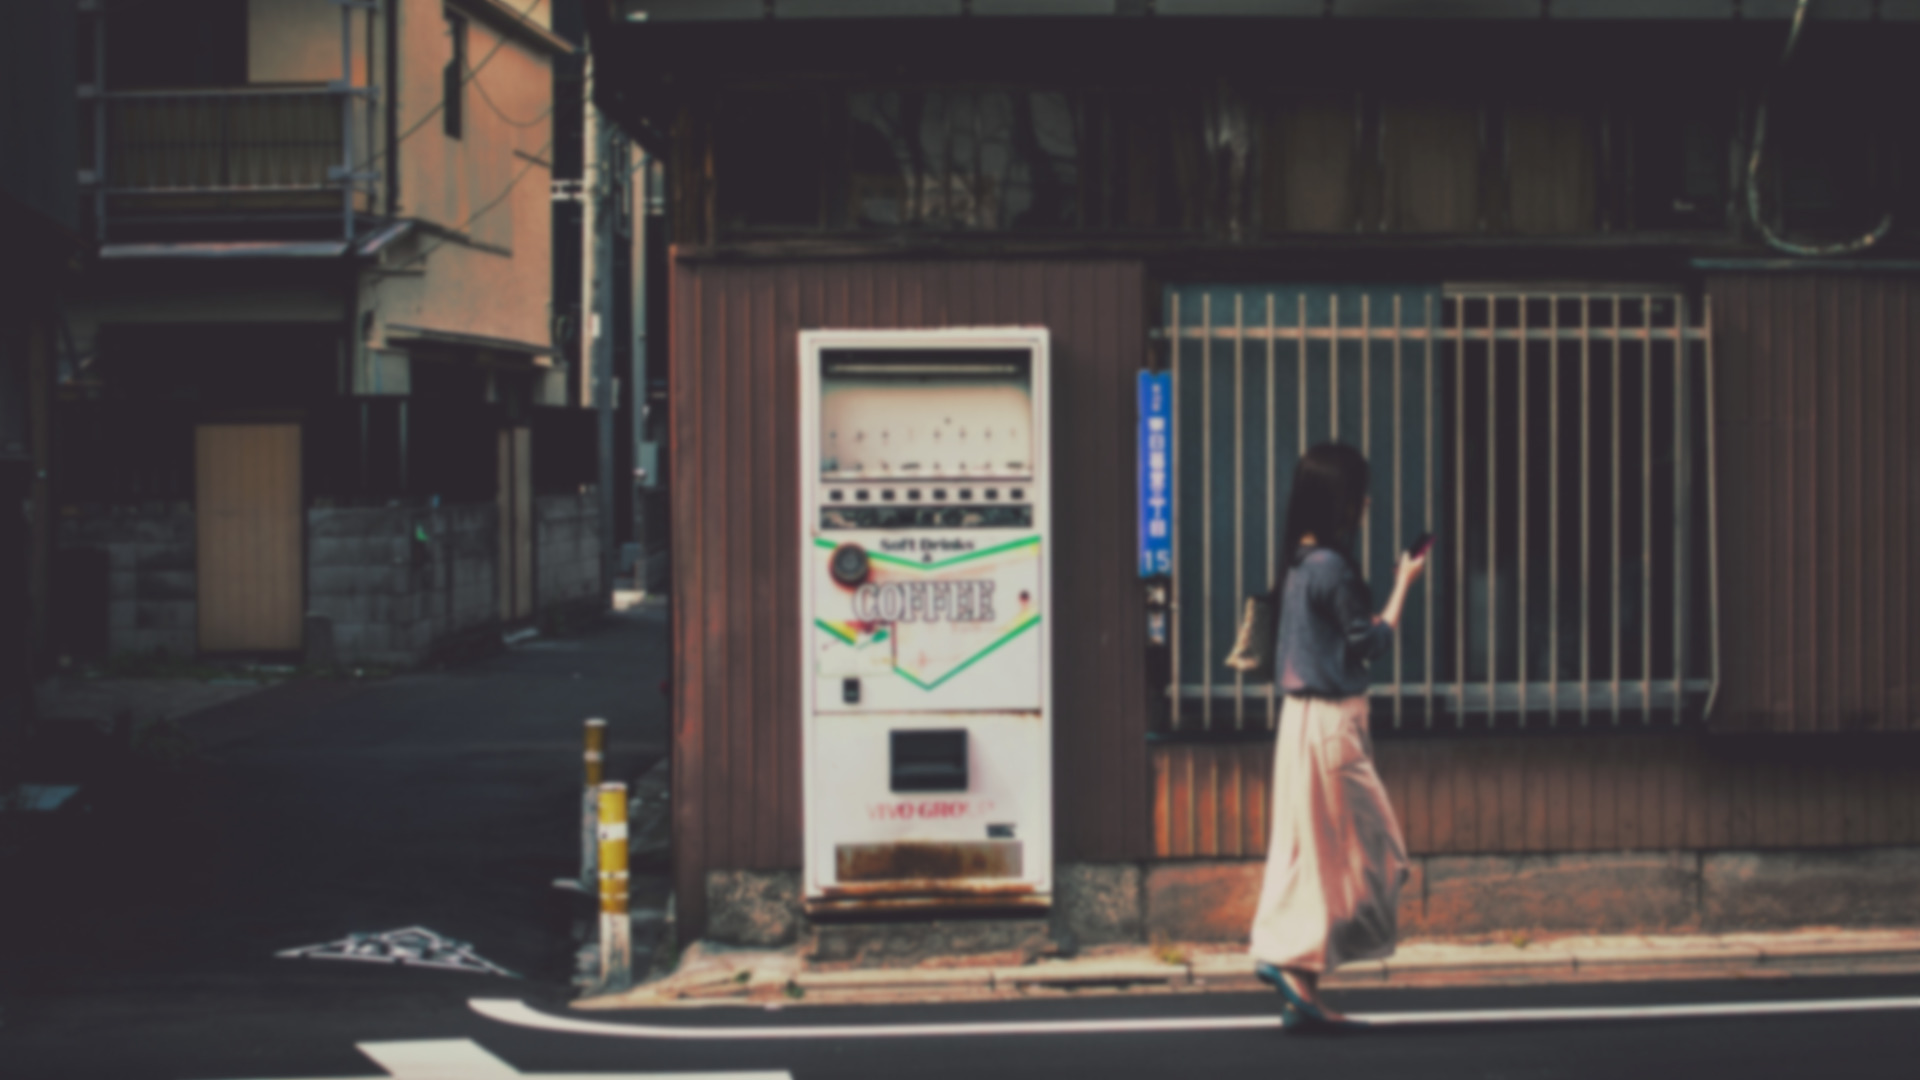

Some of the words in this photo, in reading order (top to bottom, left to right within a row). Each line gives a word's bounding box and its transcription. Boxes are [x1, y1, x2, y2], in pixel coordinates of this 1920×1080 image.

[880, 537, 915, 550] Soft
[919, 537, 975, 550] Drinks
[1145, 550, 1170, 572] 15
[853, 580, 995, 624] COFFEE
